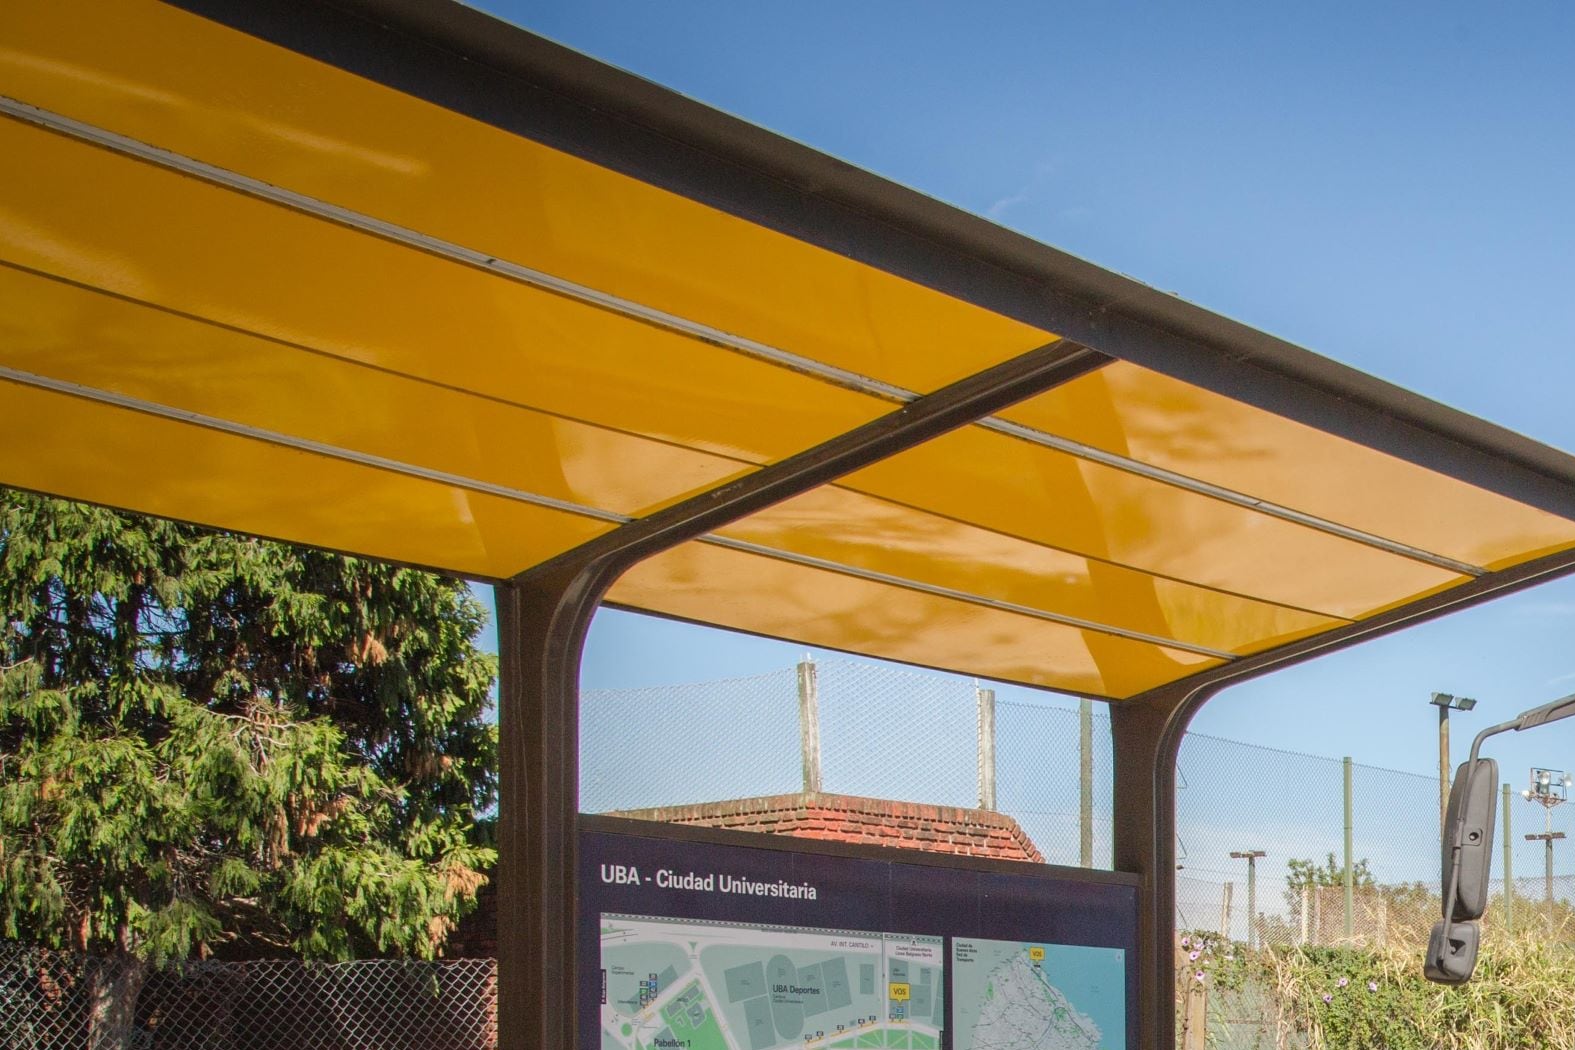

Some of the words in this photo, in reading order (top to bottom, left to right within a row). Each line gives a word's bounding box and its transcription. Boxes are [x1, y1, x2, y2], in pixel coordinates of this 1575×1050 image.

[601, 863, 641, 886] UBA
[656, 869, 714, 892] Ciudad
[719, 874, 817, 900] Universitaria
[772, 984, 788, 993] UBA
[789, 985, 820, 995] Deportes
[893, 987, 906, 996] VOS
